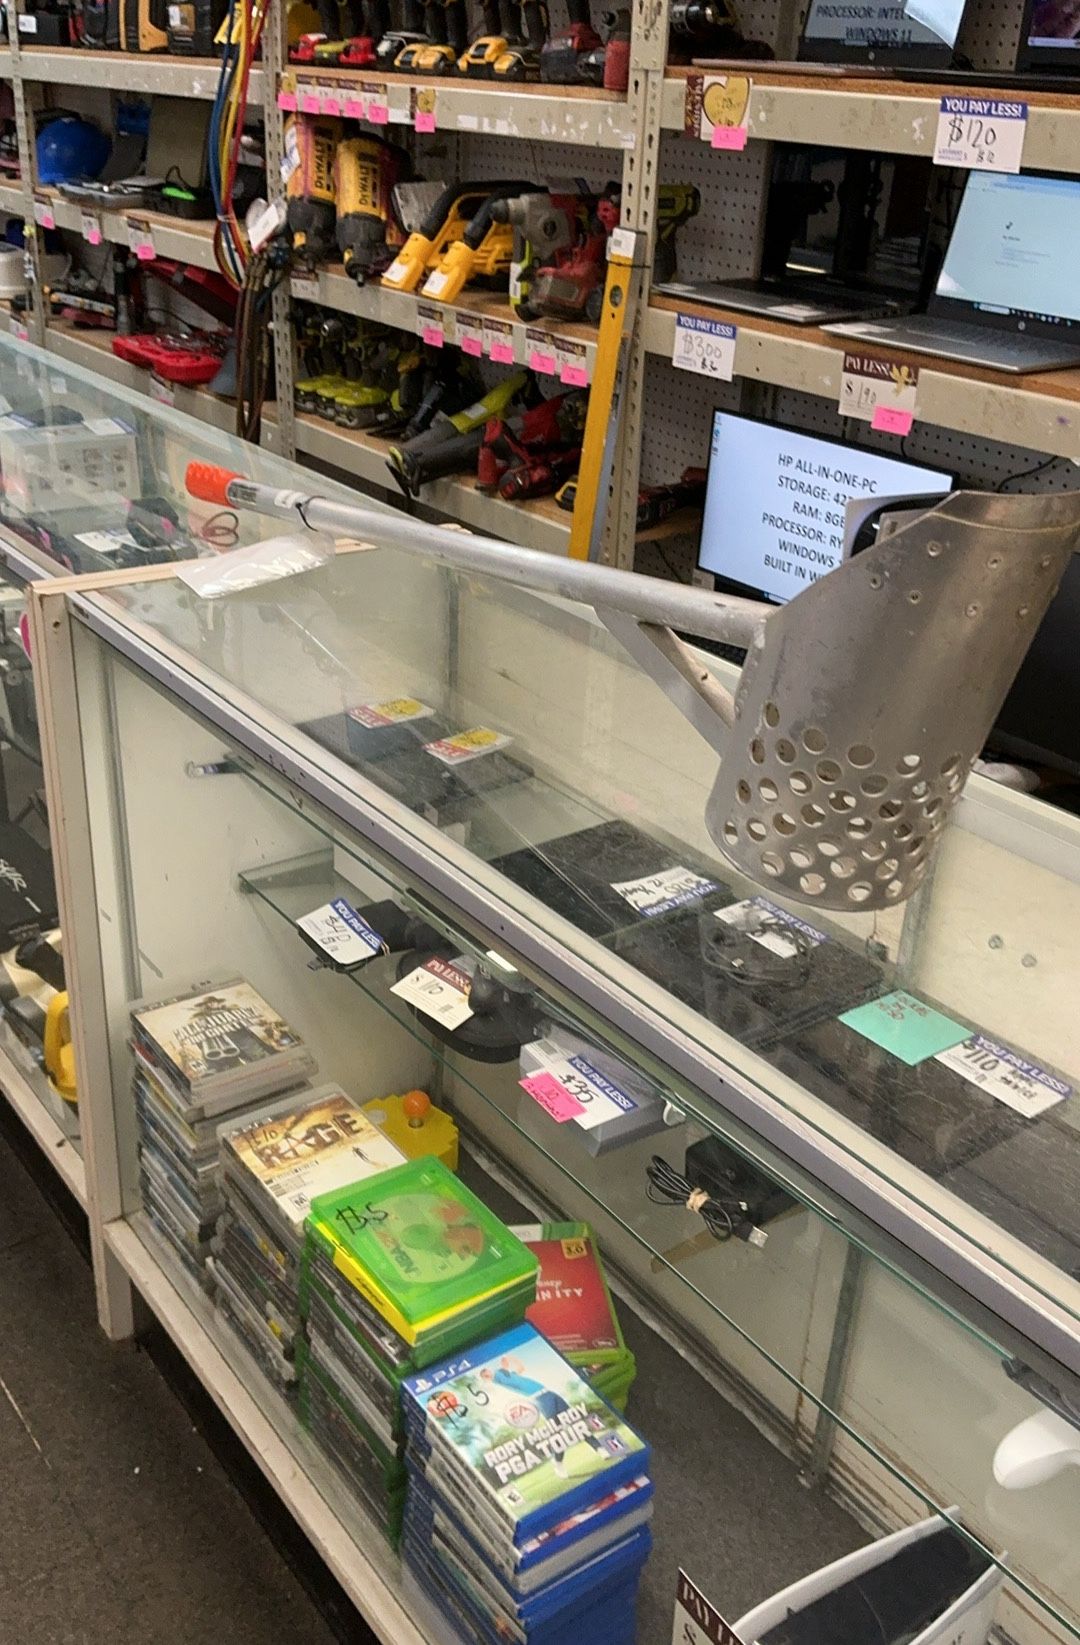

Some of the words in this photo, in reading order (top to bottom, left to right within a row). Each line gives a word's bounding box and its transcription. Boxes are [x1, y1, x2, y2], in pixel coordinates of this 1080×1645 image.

[816, 5, 873, 18] PROCESSOR:
[845, 27, 898, 41] WINDOWS
[900, 28, 912, 41] 11
[945, 98, 967, 112] YOU
[968, 100, 989, 114] PAY
[991, 102, 1022, 118] LESS!
[948, 113, 997, 148] $120
[679, 316, 698, 329] YOU
[698, 319, 713, 333] PAY
[713, 322, 734, 338] LESS!
[682, 331, 722, 359] $300
[845, 353, 861, 371] PAY
[777, 453, 793, 467] HP
[795, 458, 878, 494] ALL-IN-ONE-PC
[777, 475, 832, 502] STORAGE:
[792, 501, 822, 520] RAM:
[761, 512, 827, 544] PROCESSOR:
[763, 554, 793, 576] BUILT
[794, 564, 806, 579] IN
[777, 538, 835, 568] WINDOWS
[335, 899, 351, 917] YOU
[348, 914, 366, 933] PAY
[977, 1035, 1004, 1058] YOU
[1003, 1050, 1028, 1070] PAY
[571, 1057, 591, 1075] YOU
[589, 1071, 607, 1090] PAY
[559, 1074, 600, 1103] $35
[252, 1112, 364, 1169] RAGE
[432, 1358, 473, 1383] PS4
[509, 1404, 536, 1420] EA
[483, 1434, 525, 1468] RORY
[494, 1449, 542, 1484] PGA
[535, 1420, 593, 1457] TOUR
